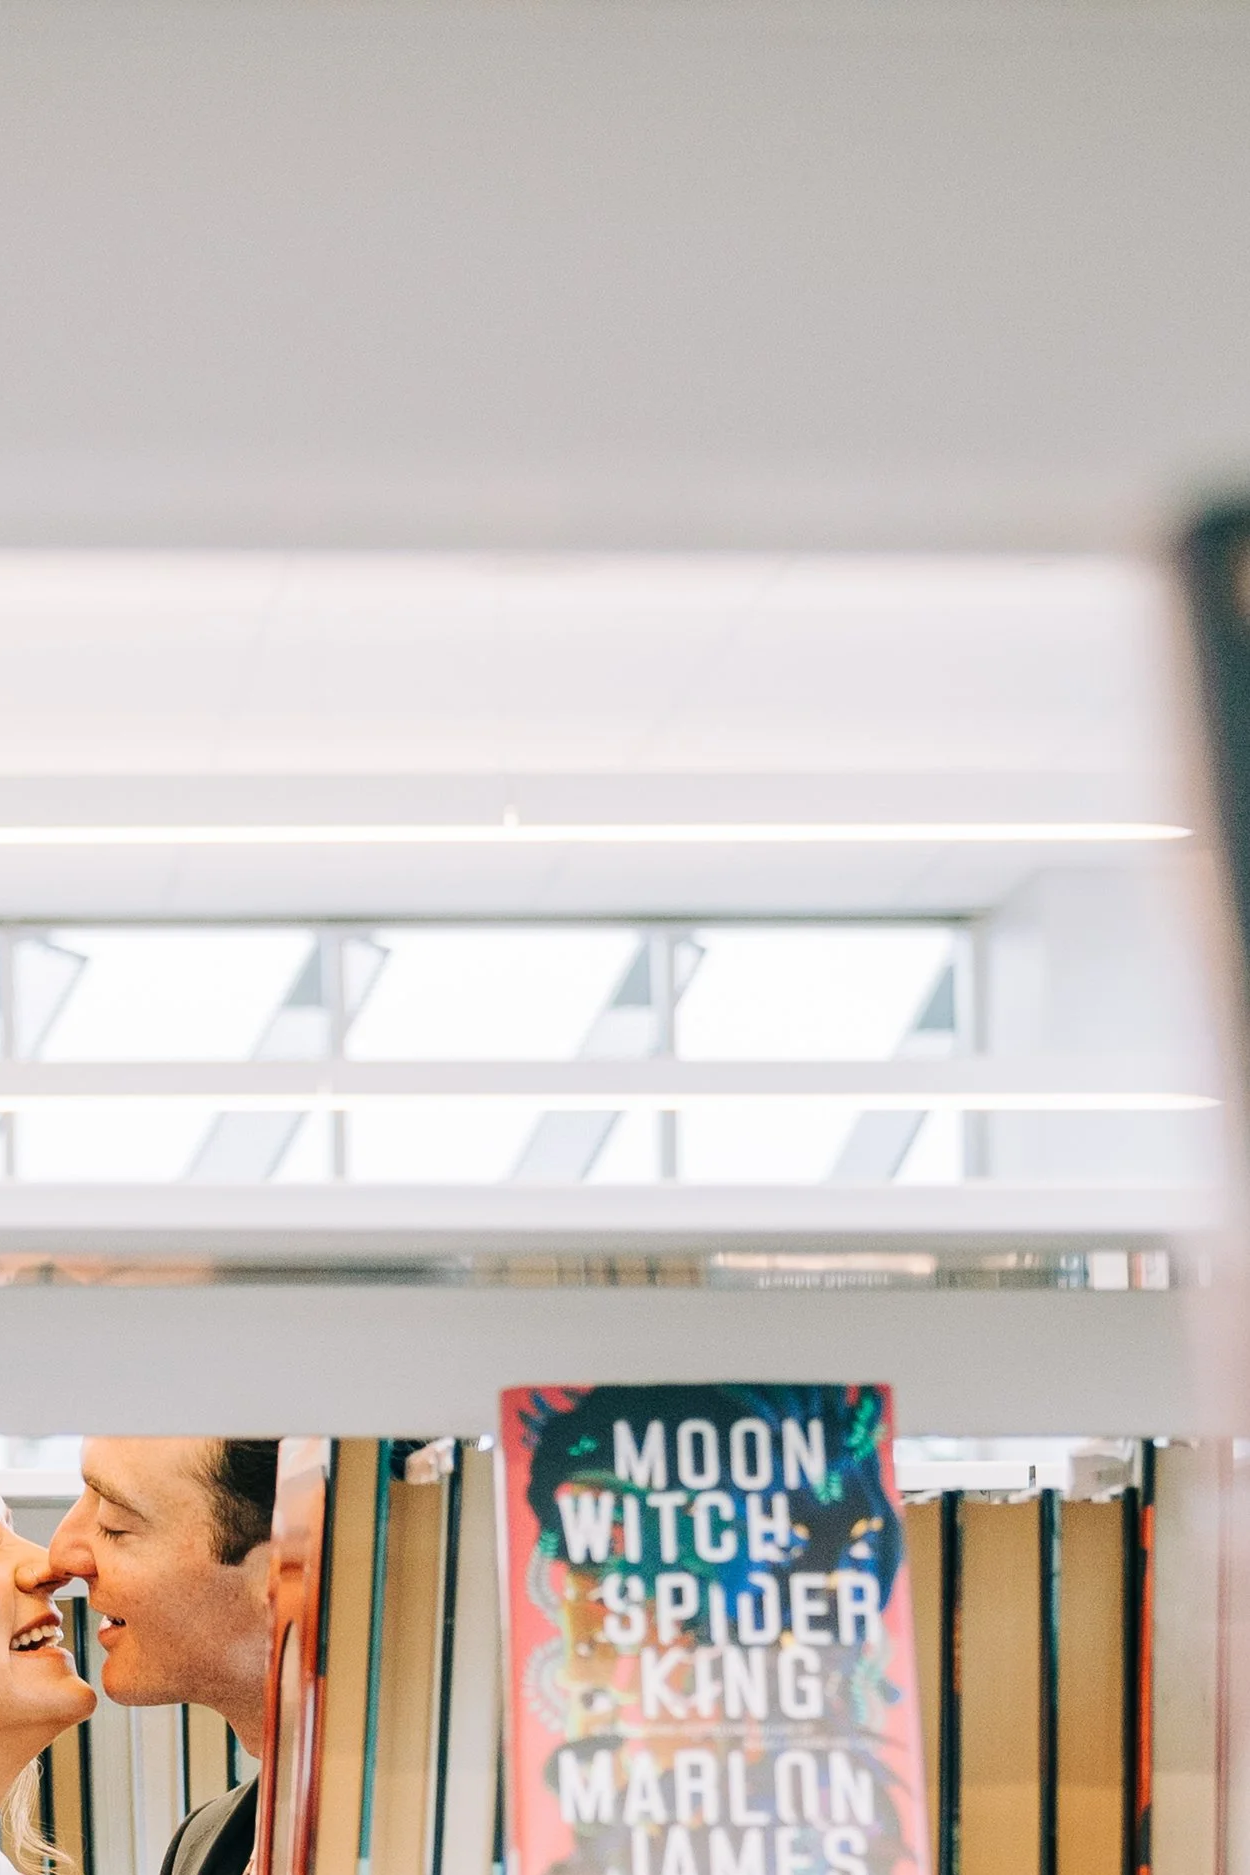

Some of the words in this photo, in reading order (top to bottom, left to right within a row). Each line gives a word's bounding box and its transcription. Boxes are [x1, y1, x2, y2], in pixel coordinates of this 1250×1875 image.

[611, 1417, 827, 1491] MOON
[557, 1491, 792, 1564] WITCH
[602, 1570, 882, 1647] SPIDER
[641, 1645, 824, 1721] KING
[557, 1749, 875, 1827] MARLON
